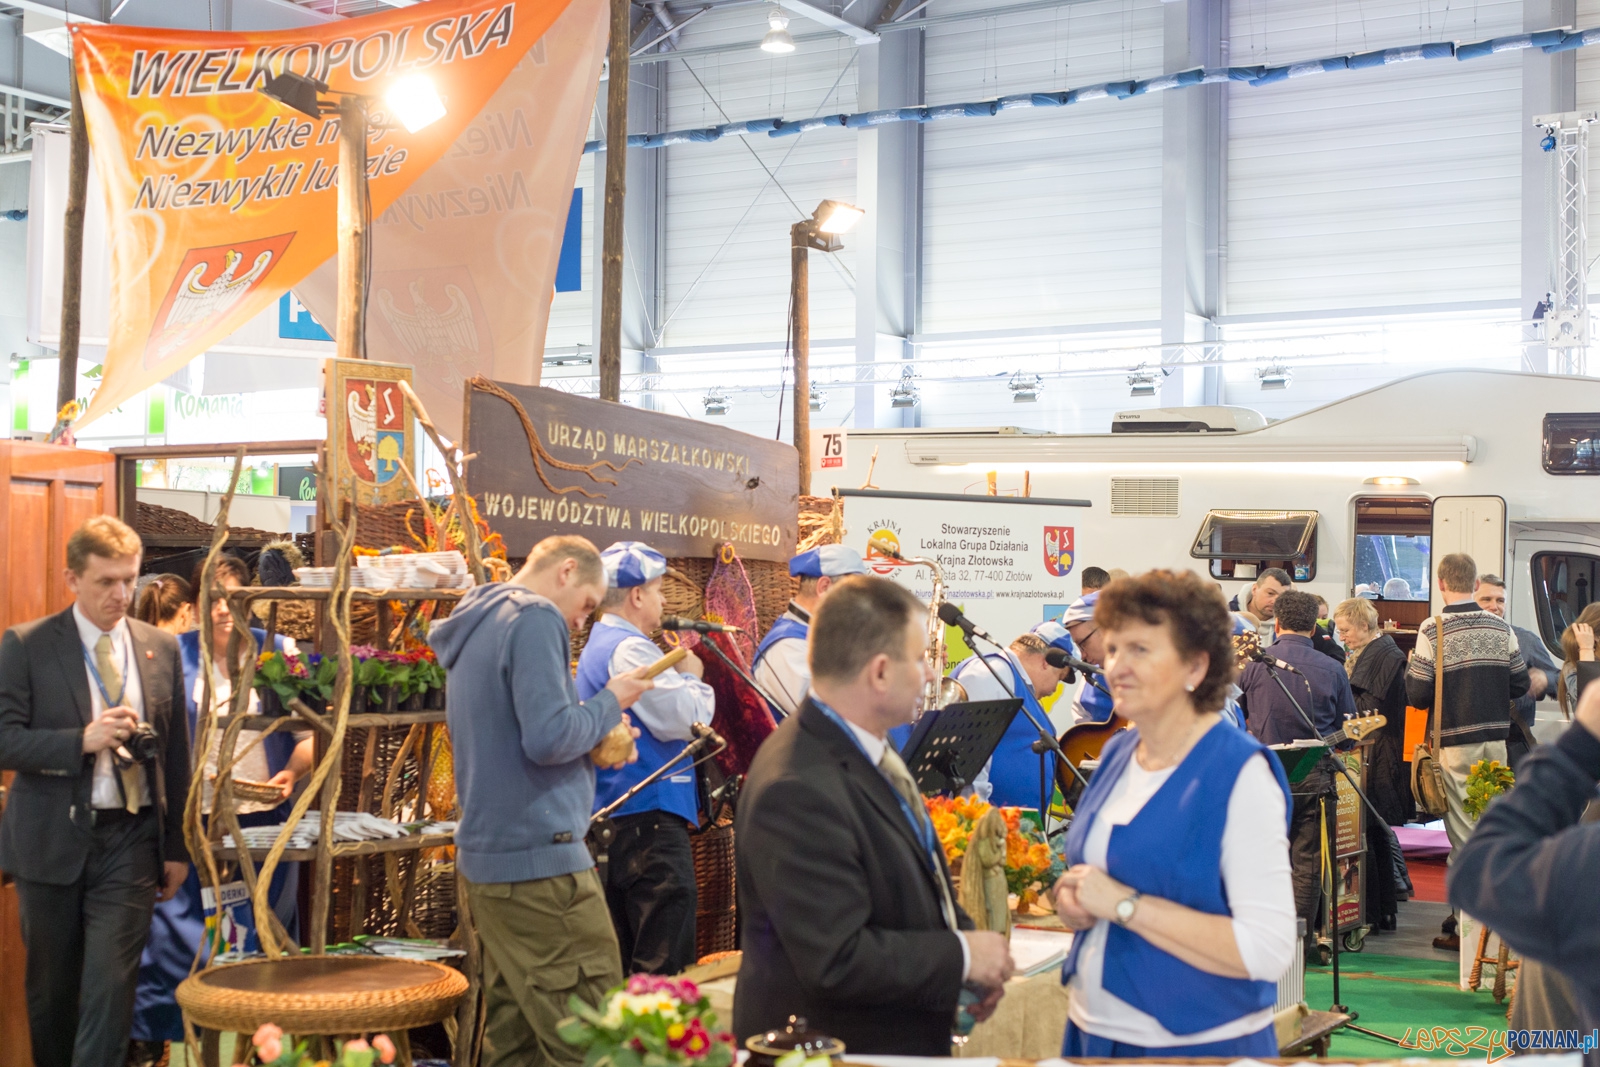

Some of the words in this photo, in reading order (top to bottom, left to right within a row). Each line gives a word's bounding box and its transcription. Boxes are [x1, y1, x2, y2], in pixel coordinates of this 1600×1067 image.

[128, 4, 514, 98] WIELKOPOLSKA
[137, 117, 311, 162] Niezwykłe
[134, 162, 302, 212] Niezwykli
[301, 146, 408, 194] luzie
[548, 422, 607, 460] URZĄD
[613, 433, 750, 475] MARSZAŁKOWSKI
[823, 433, 842, 456] 75
[484, 491, 631, 529] WOJEWÓDZTWA
[640, 509, 781, 547] WIELKOPOLSKIEGO
[867, 519, 902, 535] KRAJNA
[941, 523, 1011, 538] Stowarzyszenie
[920, 538, 957, 550] Lokalna
[959, 539, 987, 553] Grupa
[989, 540, 1029, 552] Działania
[936, 554, 966, 567] Krajna
[968, 555, 1014, 566] Złotowska
[915, 570, 927, 580] Al.
[959, 570, 972, 582] 32,
[974, 570, 1004, 581] 77-400
[1006, 570, 1033, 582] Złotów
[996, 590, 1064, 599] www.krajnazlotowska.pl
